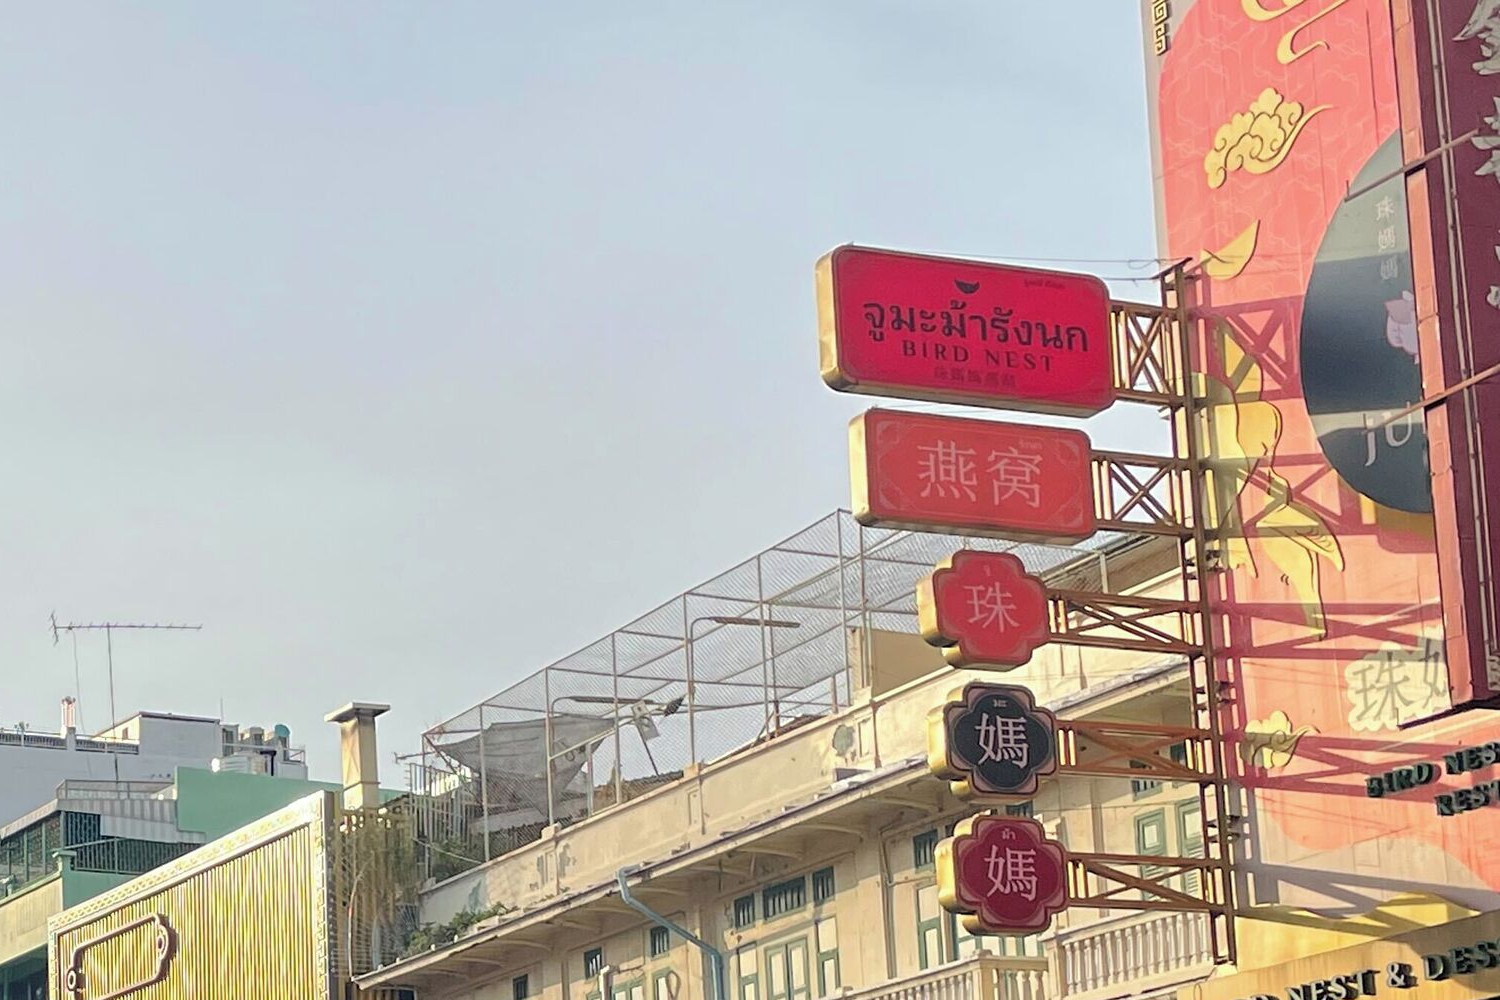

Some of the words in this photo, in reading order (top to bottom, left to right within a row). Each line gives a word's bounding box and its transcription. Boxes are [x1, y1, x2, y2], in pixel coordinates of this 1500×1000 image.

[863, 300, 1088, 352] จูมะม้ารังนก
[903, 339, 970, 363] BIRD
[985, 350, 1053, 372] NEST
[916, 440, 1043, 508] 燕窝
[963, 581, 1020, 633] 珠
[974, 712, 1029, 769] 媽
[1443, 741, 1500, 775] NES
[984, 844, 1038, 901] 媽
[1386, 961, 1414, 988] &
